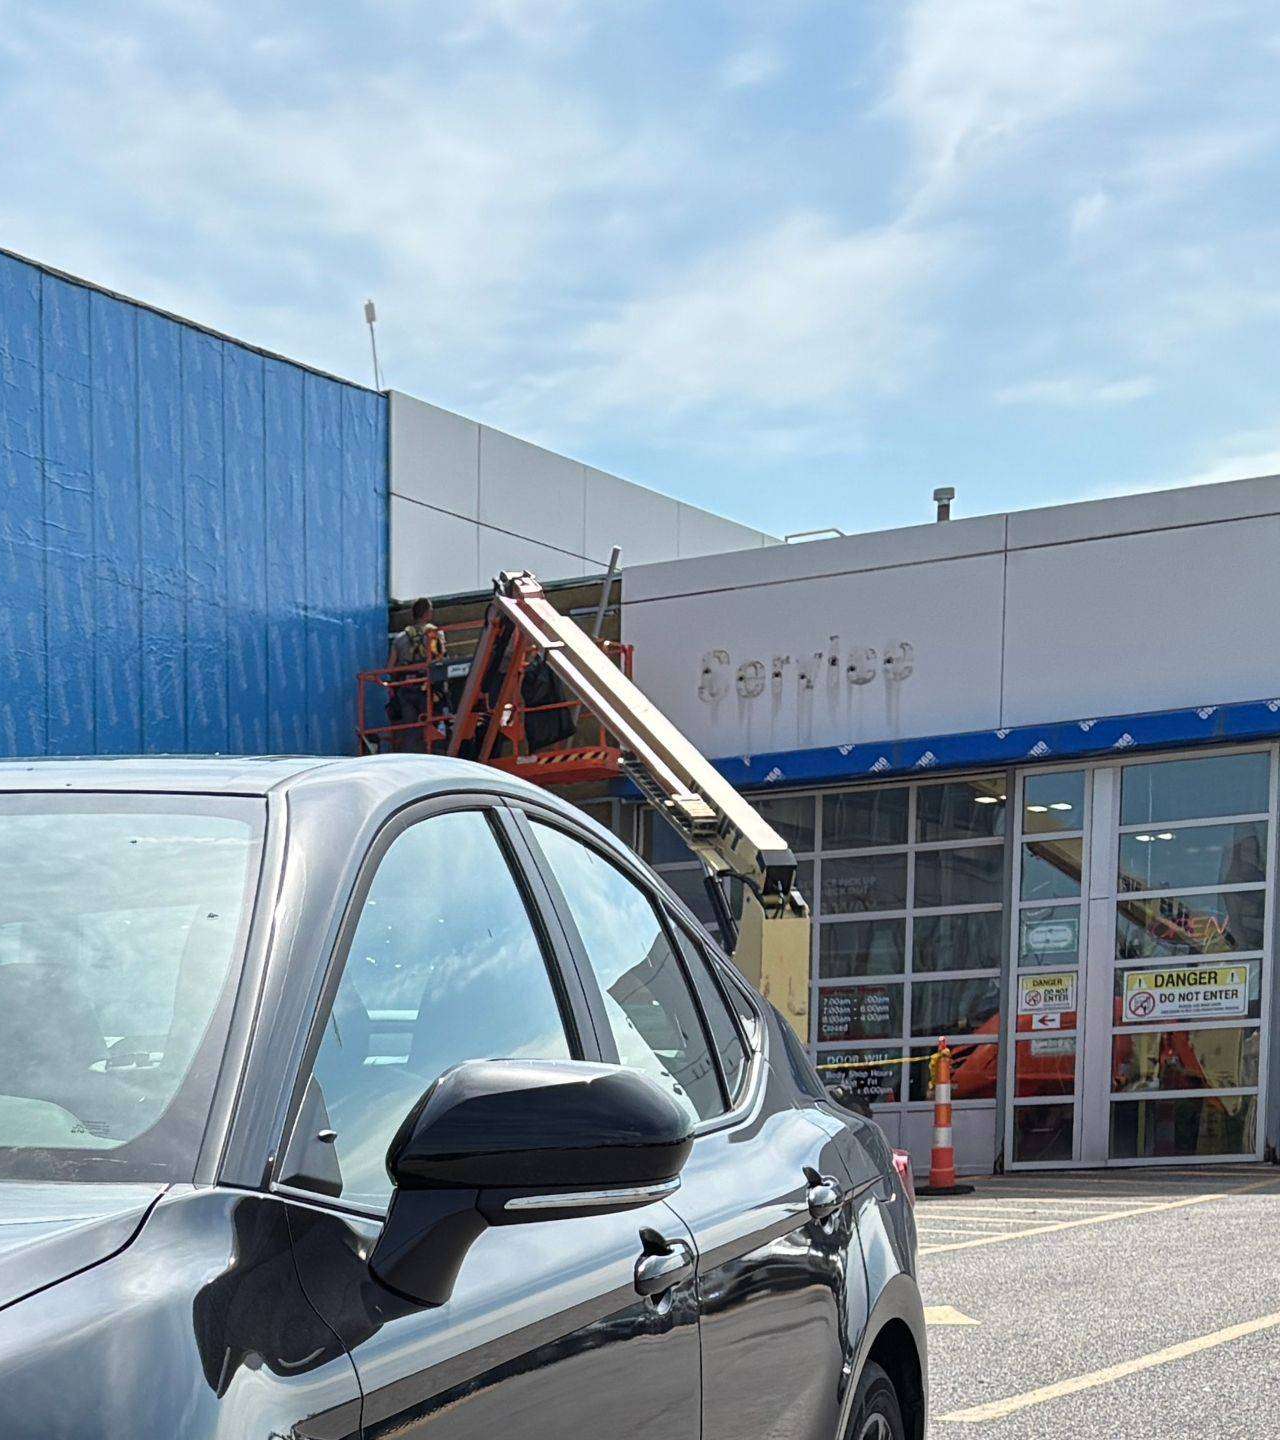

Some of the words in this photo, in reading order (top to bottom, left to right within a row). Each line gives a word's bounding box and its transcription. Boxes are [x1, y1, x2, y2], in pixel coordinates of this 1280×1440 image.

[1032, 978, 1063, 987] DANGER
[1154, 971, 1218, 988] DANGER
[1159, 993, 1175, 1003] DO
[1178, 991, 1201, 1002] NOT
[1203, 989, 1238, 1001] ENTER
